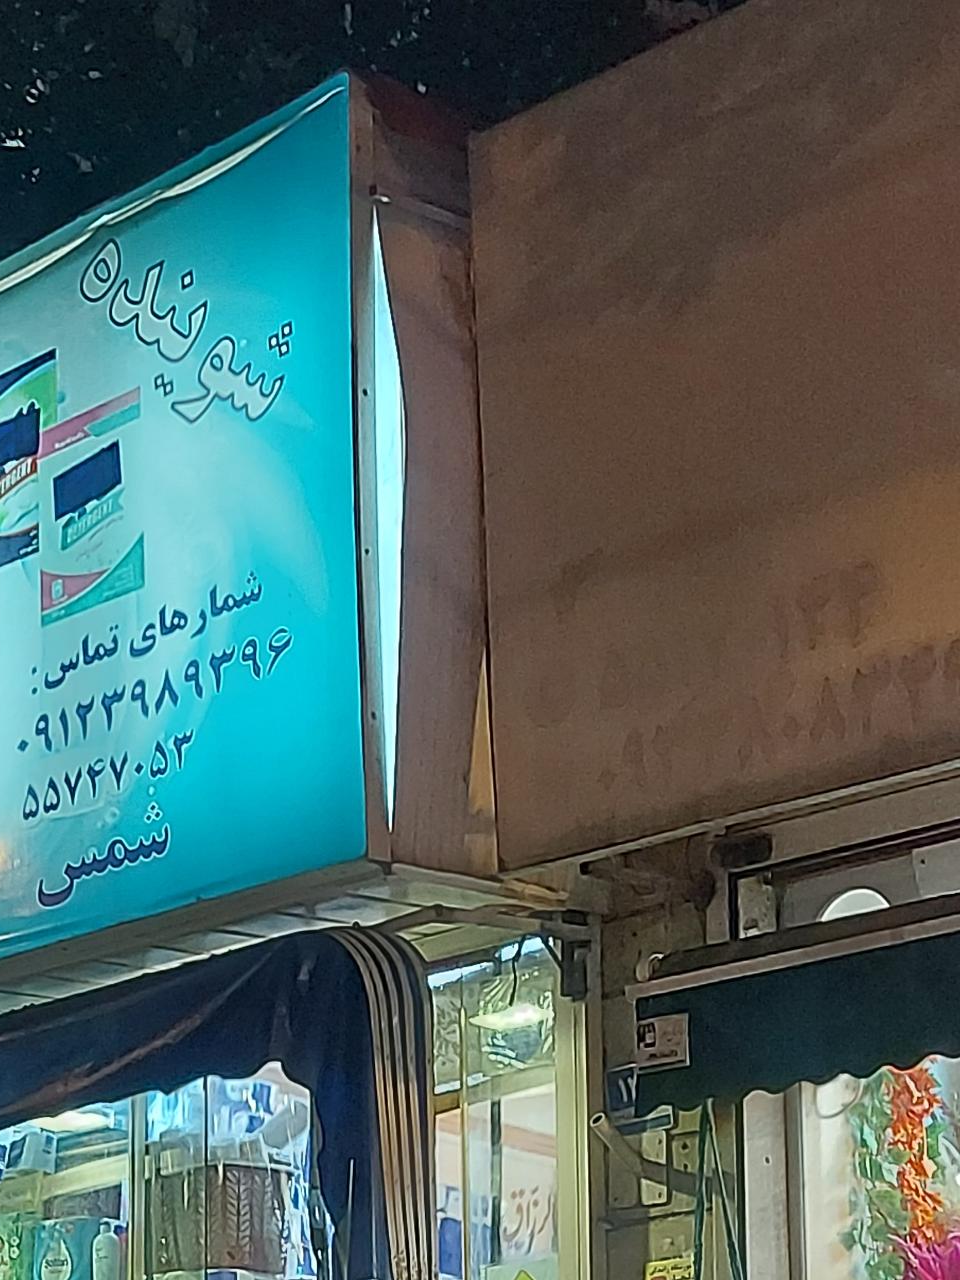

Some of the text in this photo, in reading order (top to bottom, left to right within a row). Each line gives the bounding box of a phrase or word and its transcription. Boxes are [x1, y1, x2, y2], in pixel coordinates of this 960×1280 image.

[80, 237, 295, 423] شوینده
[21, 727, 195, 822] ۵۵۷۴۷۰۵۳
[36, 803, 172, 907] شمس
